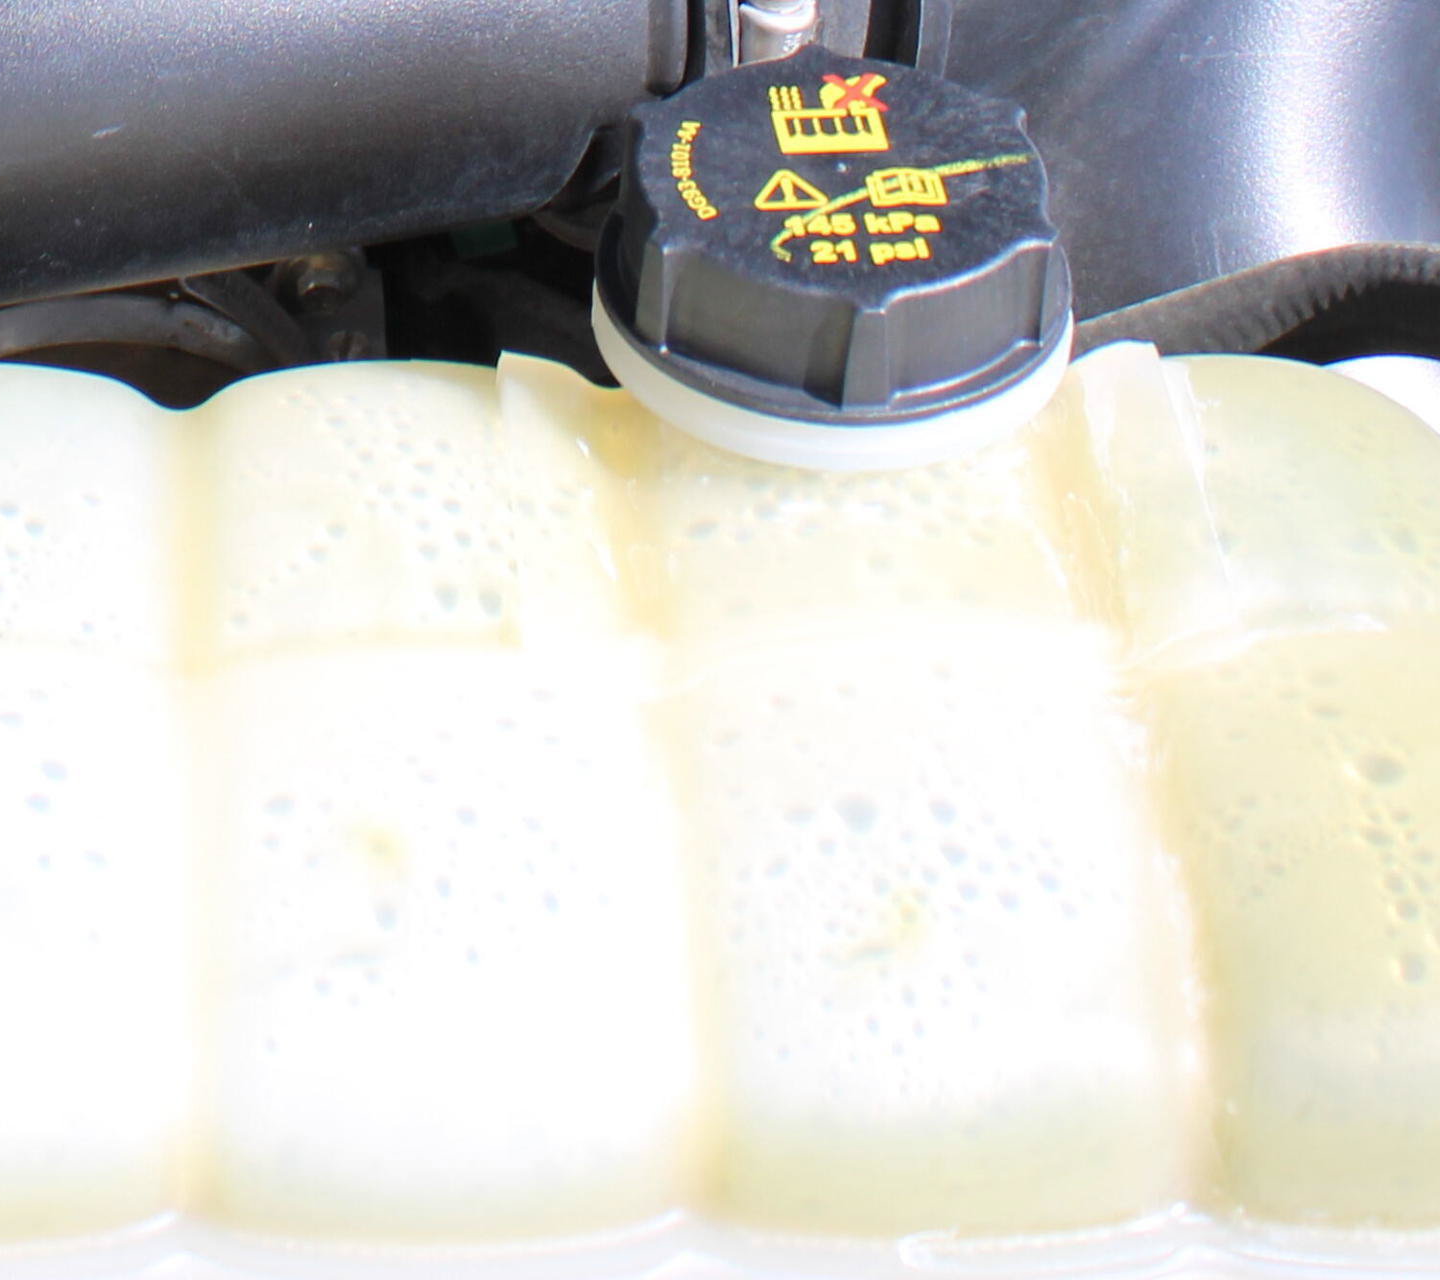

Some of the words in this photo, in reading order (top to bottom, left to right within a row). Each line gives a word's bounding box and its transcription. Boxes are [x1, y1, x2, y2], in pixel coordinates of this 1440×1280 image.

[784, 212, 857, 238] 145
[863, 210, 942, 236] kPa
[809, 238, 858, 265] 21
[868, 235, 932, 267] psi
